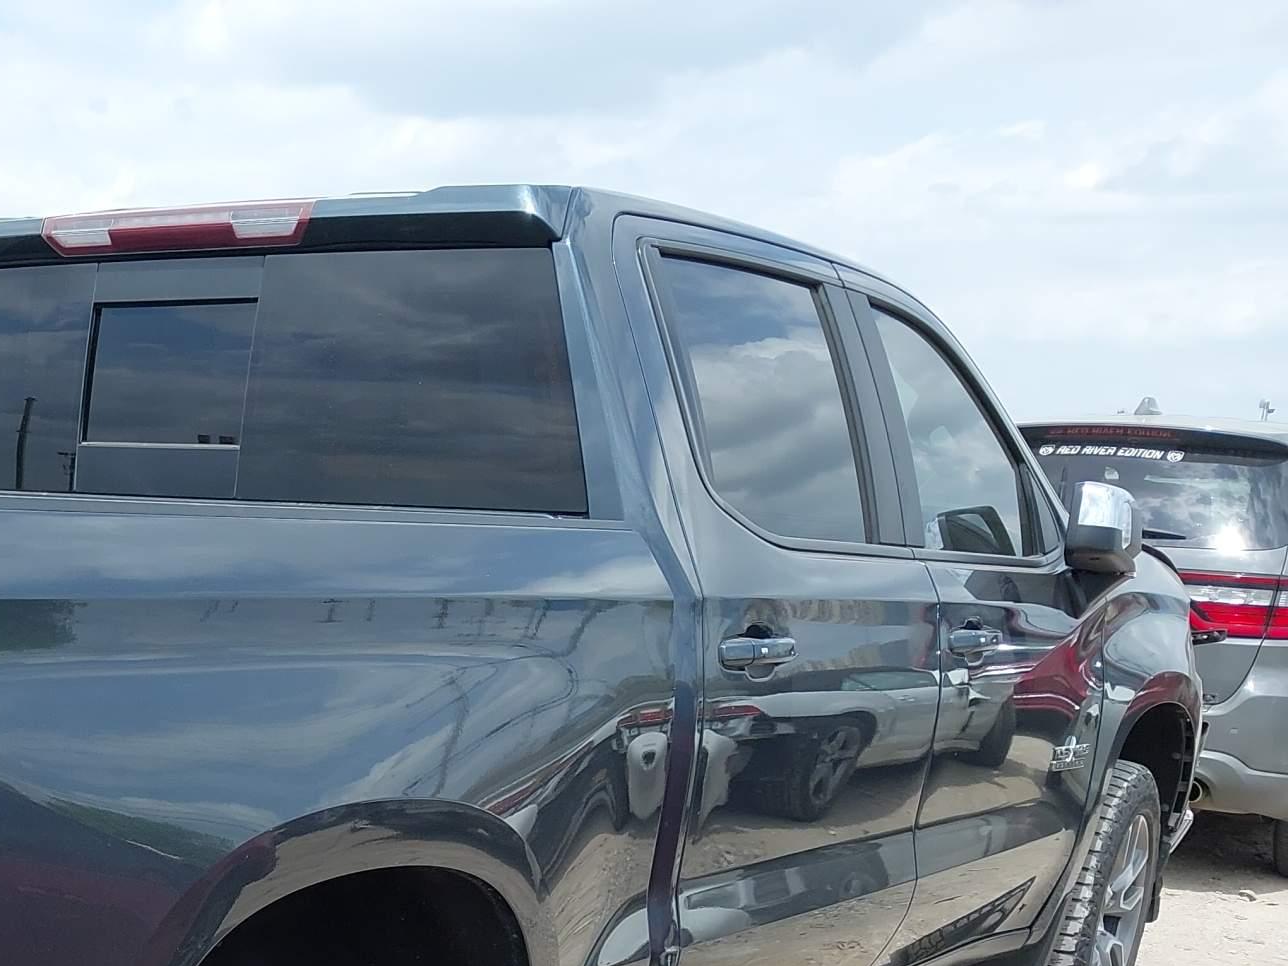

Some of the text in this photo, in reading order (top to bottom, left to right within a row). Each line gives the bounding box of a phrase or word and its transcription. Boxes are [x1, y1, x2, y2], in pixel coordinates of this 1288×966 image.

[1056, 445, 1164, 460] RED RIVER EDITION
